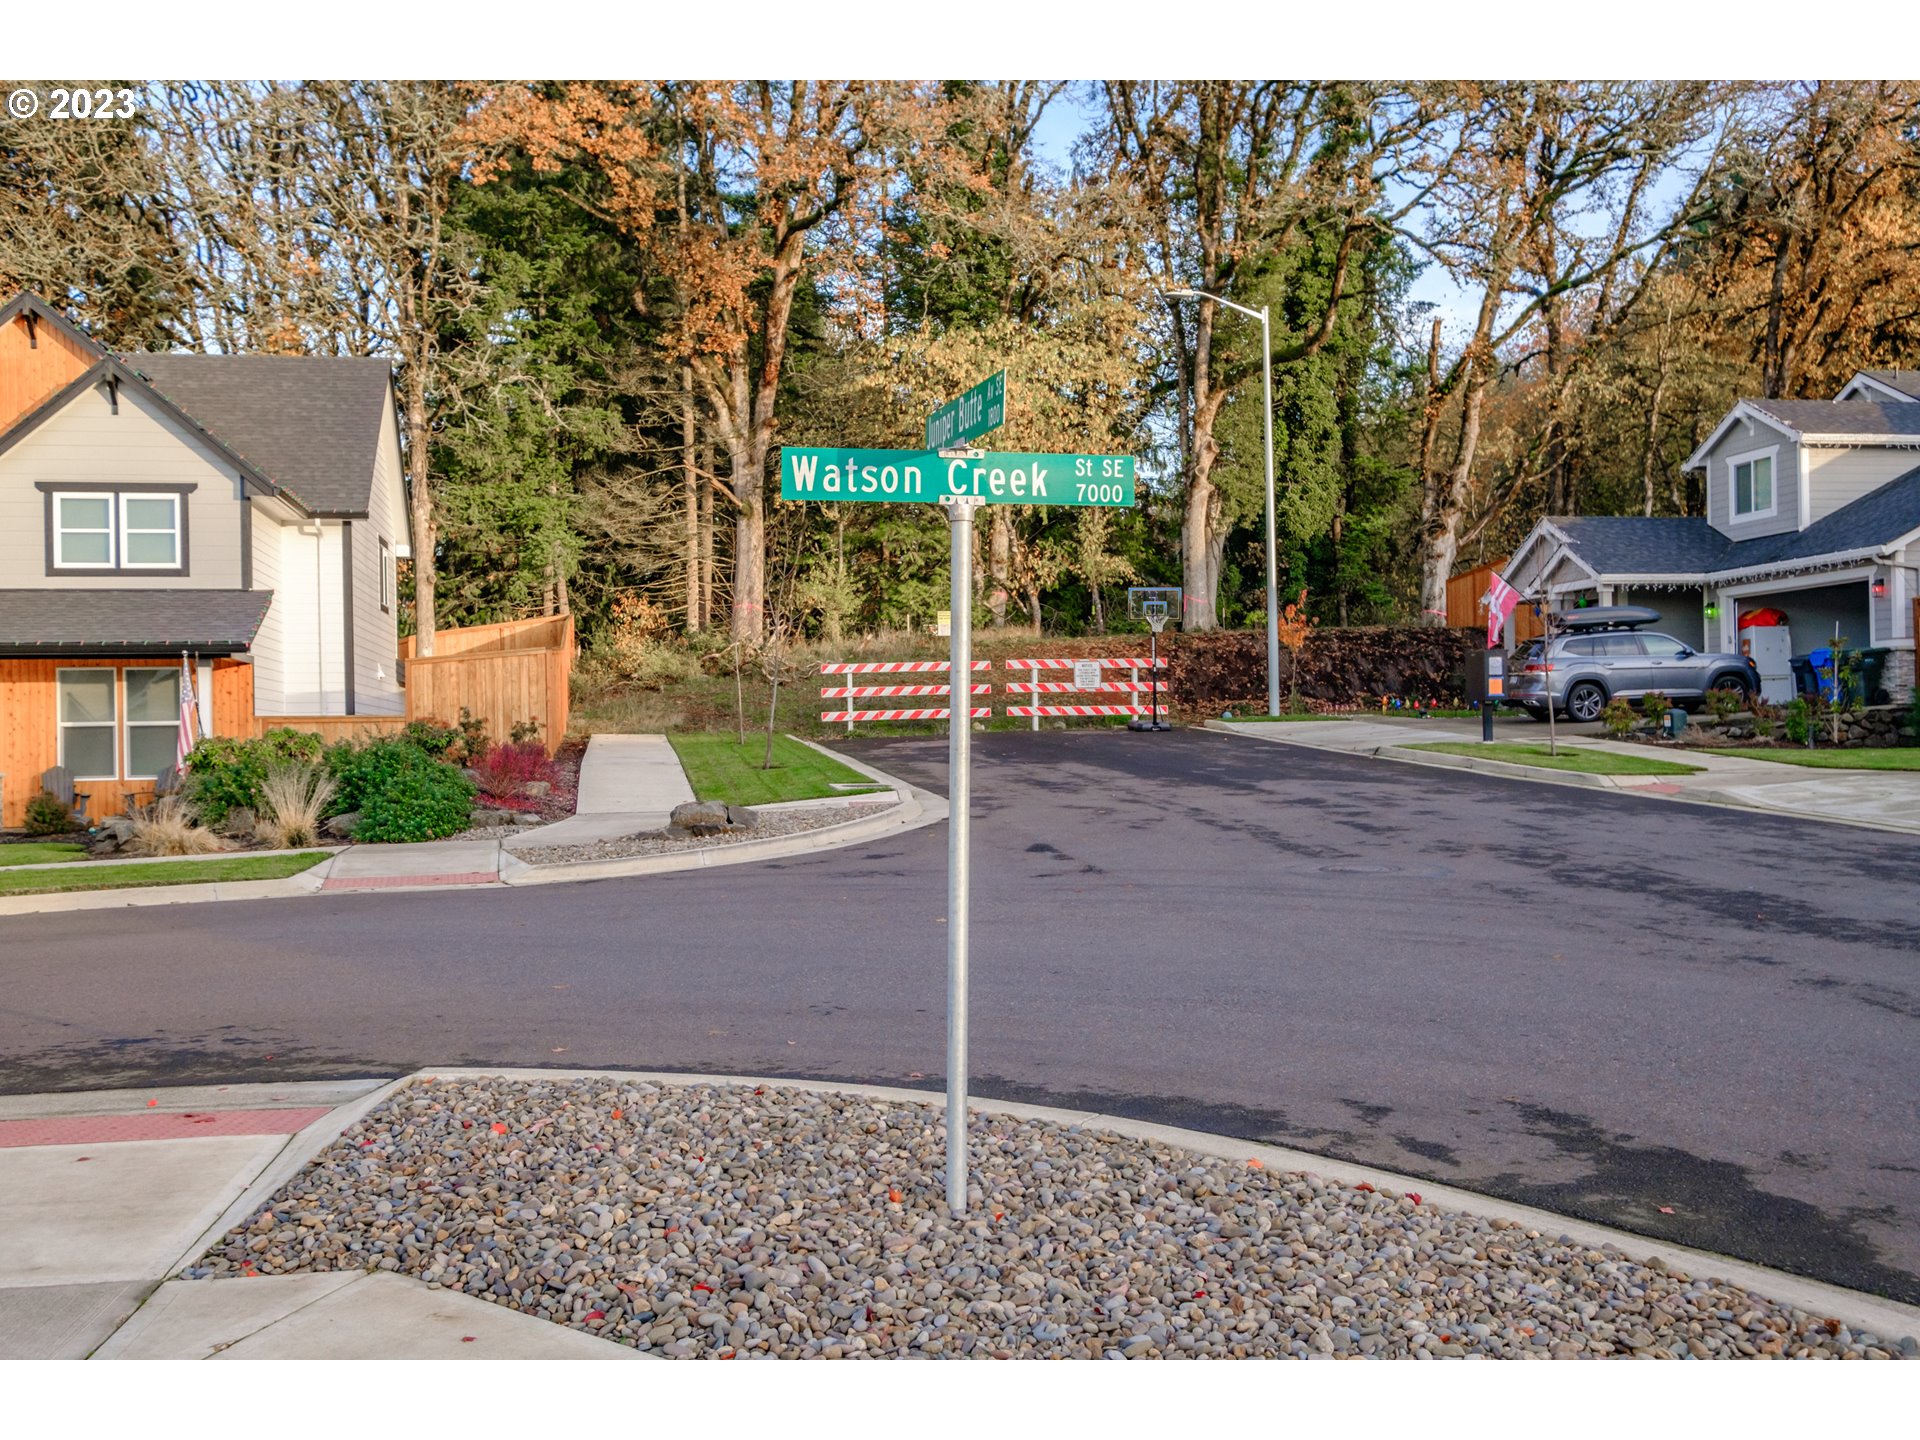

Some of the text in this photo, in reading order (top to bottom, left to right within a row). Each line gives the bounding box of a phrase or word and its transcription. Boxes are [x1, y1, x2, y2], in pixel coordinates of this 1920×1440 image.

[926, 410, 955, 450] Juniper
[958, 389, 983, 433] Butte
[995, 374, 1003, 397] SE
[791, 455, 1124, 497] Watson Creek St SE
[1075, 483, 1123, 503] 7000
